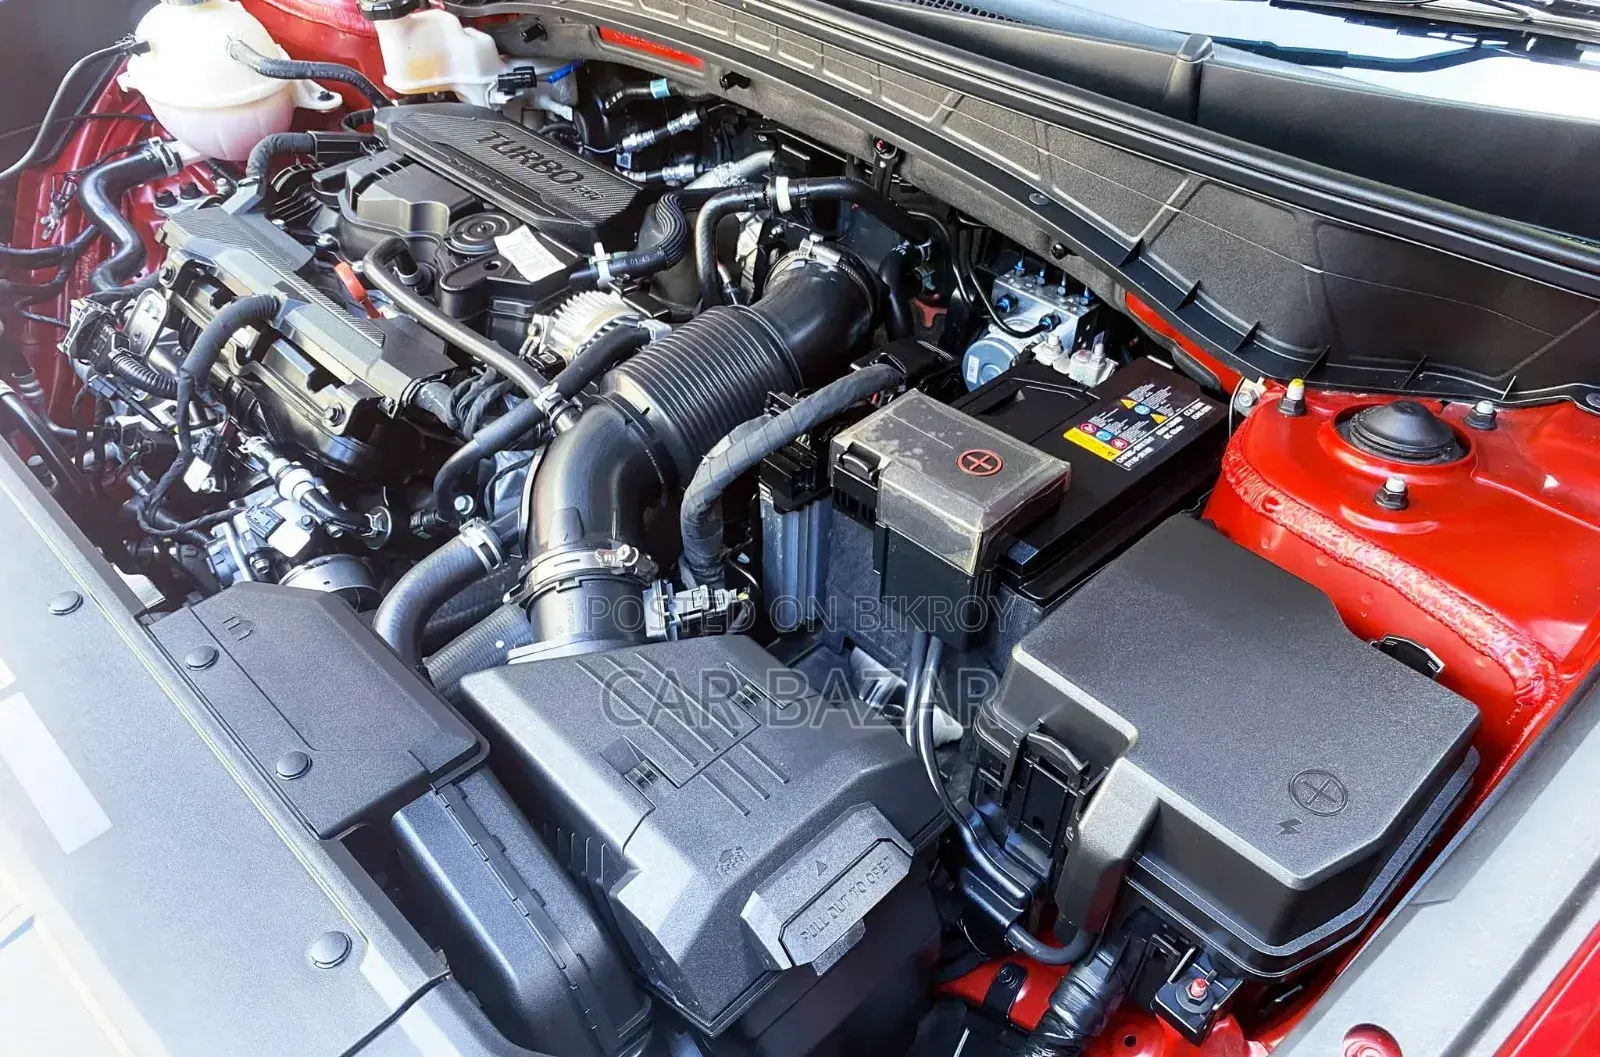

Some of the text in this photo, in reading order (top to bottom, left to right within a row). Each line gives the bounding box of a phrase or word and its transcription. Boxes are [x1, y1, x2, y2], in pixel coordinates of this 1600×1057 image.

[476, 130, 584, 184] TURBO
[800, 855, 892, 941] PULL OUT TO OPEN
